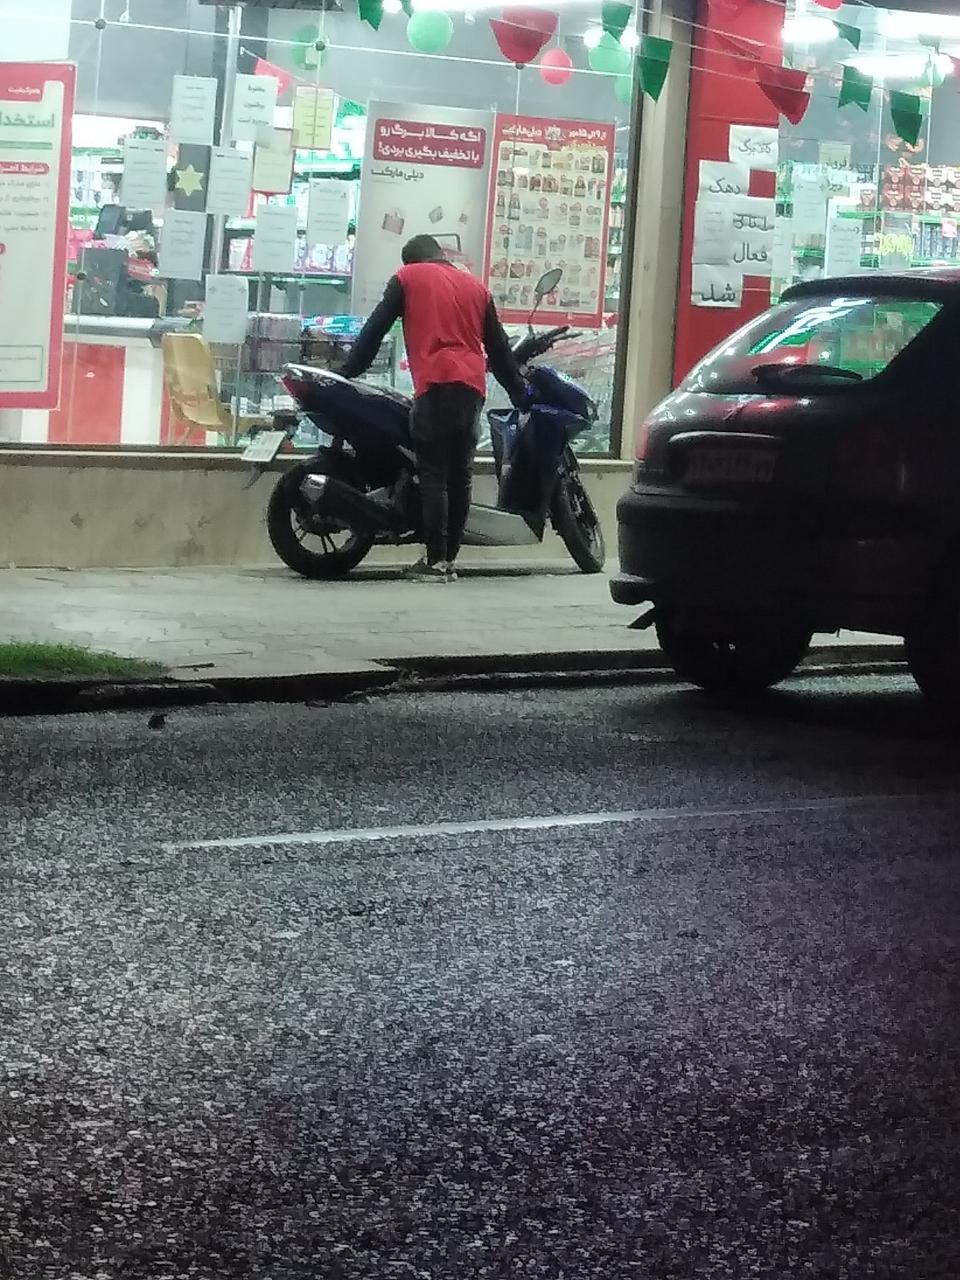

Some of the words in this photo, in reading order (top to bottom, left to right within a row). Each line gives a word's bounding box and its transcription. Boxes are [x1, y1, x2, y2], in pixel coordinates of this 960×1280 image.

[405, 145, 437, 160] بگیری
[439, 147, 470, 162] تخفیف
[708, 177, 742, 195] دهک
[733, 241, 768, 263] فعال
